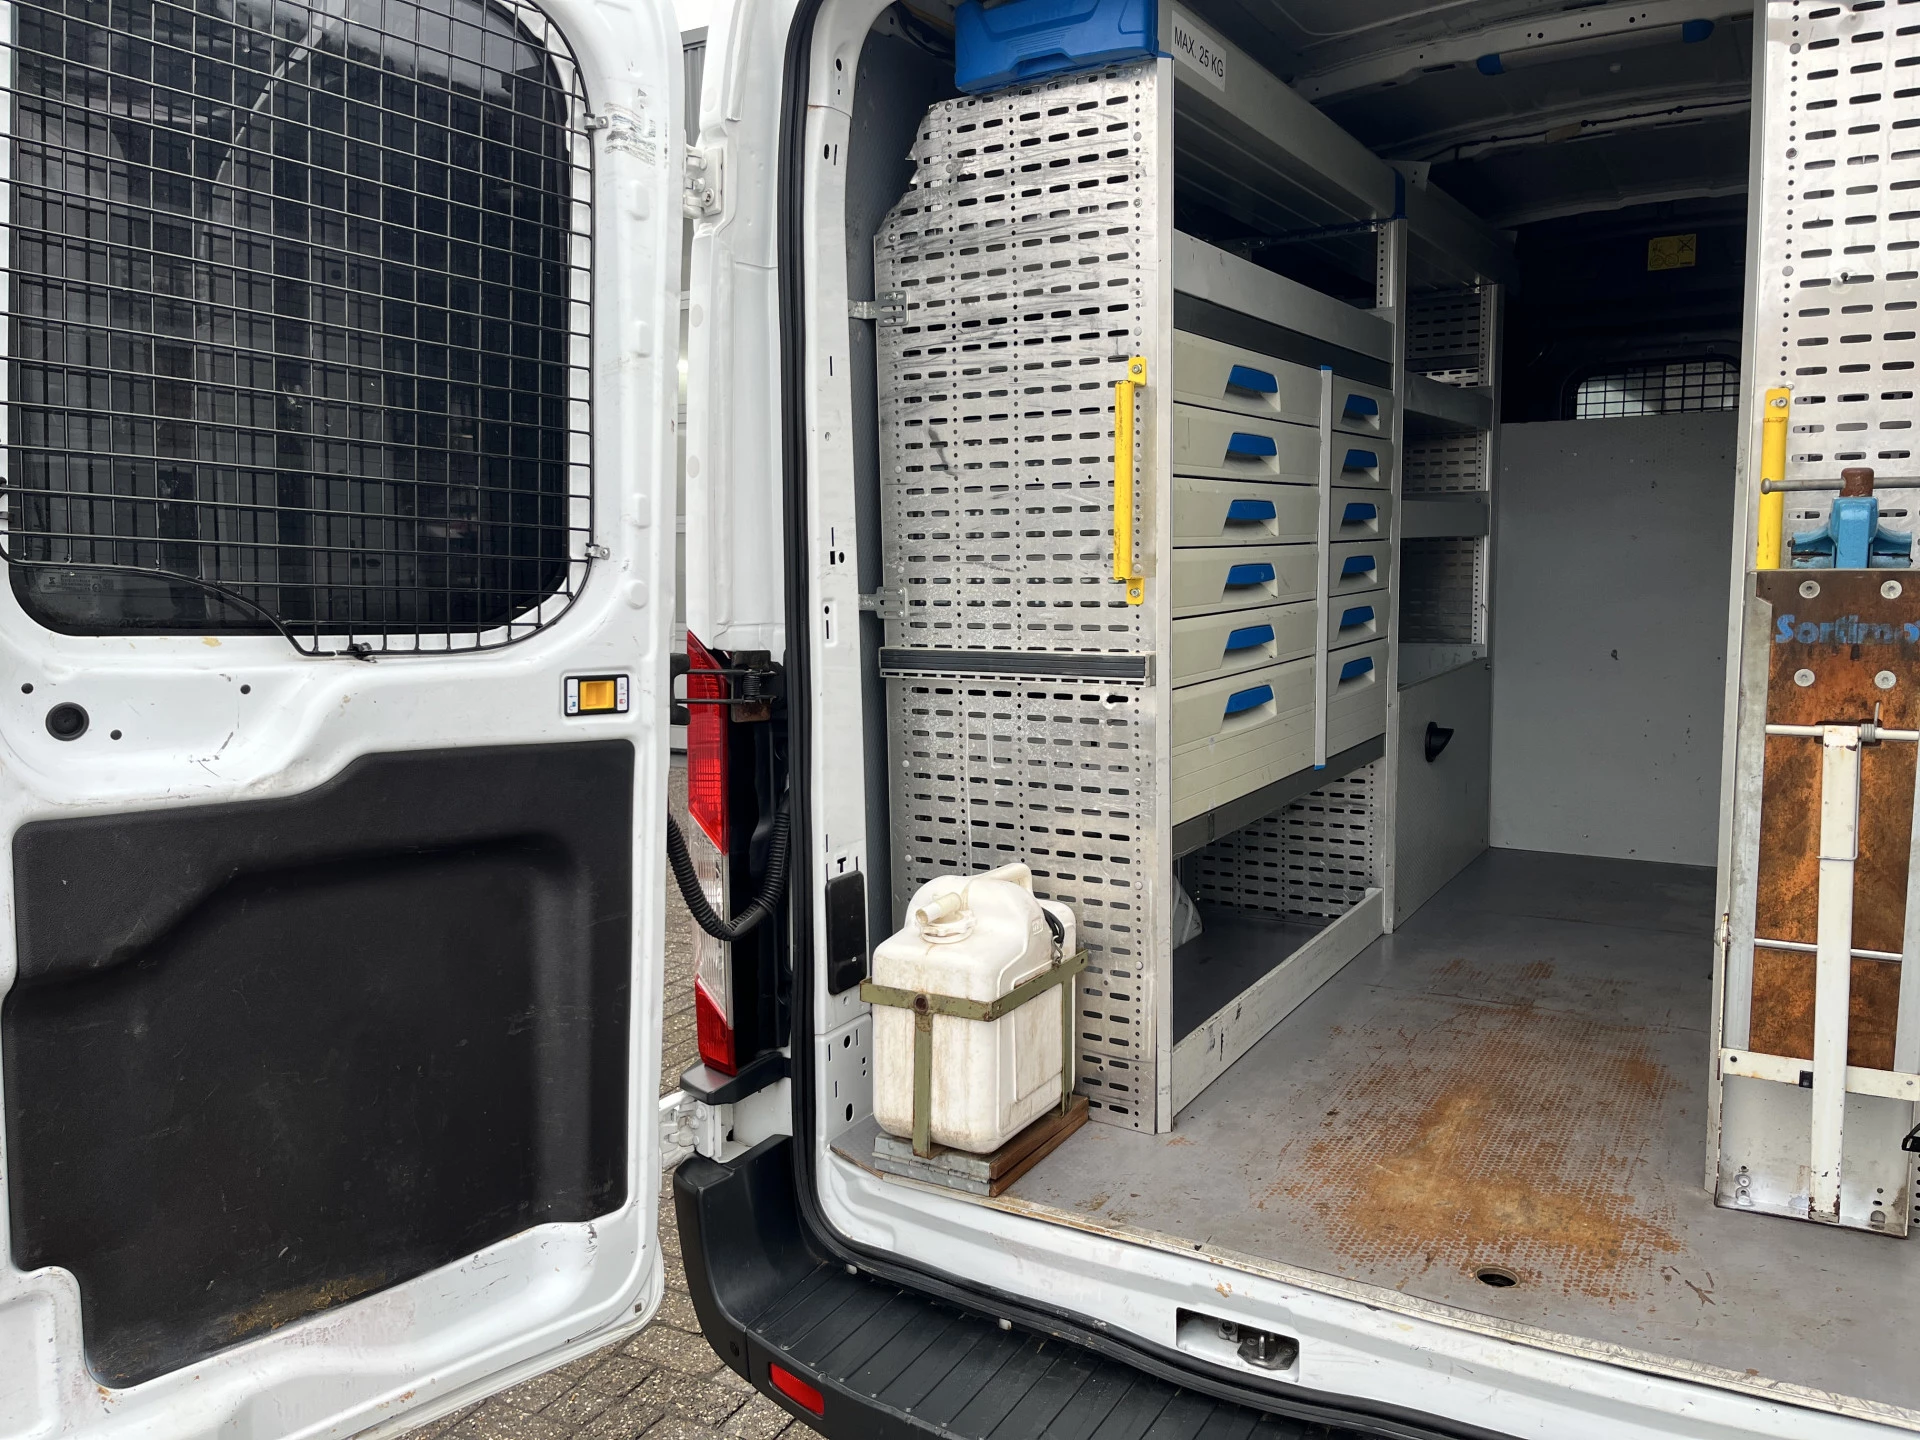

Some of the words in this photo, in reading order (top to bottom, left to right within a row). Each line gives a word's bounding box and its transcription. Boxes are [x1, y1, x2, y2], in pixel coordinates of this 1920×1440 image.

[1174, 26, 1197, 58] MAX.
[1199, 46, 1210, 68] 25
[1211, 53, 1224, 78] KG
